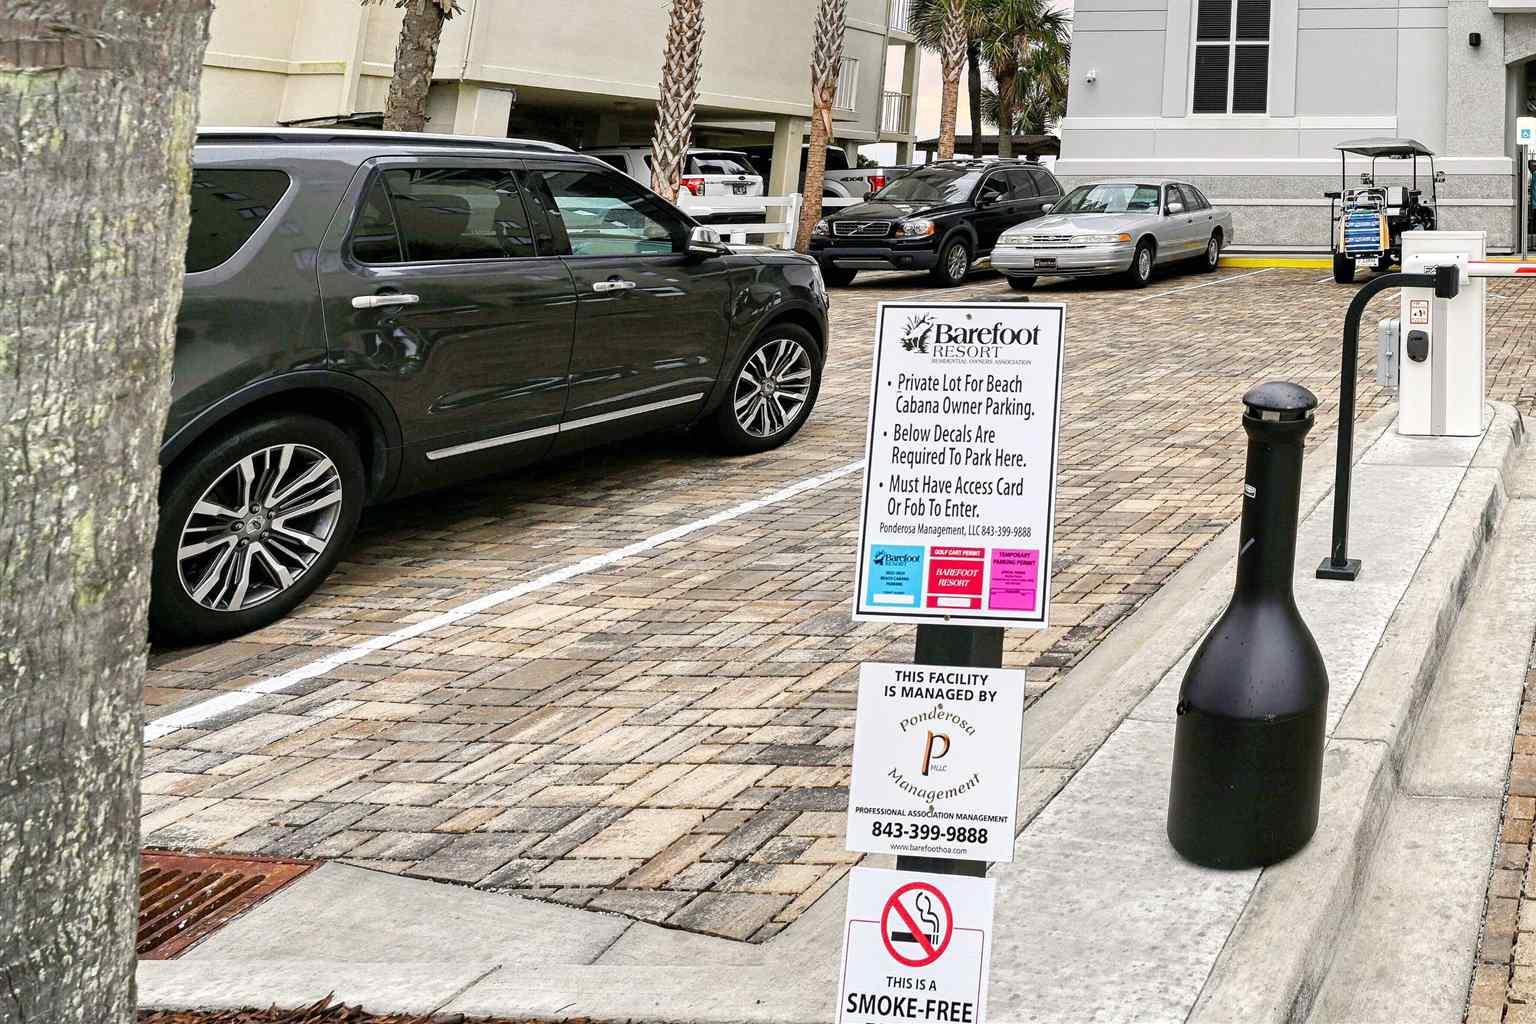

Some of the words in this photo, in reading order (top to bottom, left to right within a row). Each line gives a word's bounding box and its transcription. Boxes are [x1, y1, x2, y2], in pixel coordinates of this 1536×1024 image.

[935, 322, 1040, 346] Barefoot
[933, 345, 1001, 358] RESORT
[898, 373, 939, 392] Private
[942, 374, 961, 392] Lot
[964, 375, 983, 392] For
[986, 375, 1023, 393] Beach
[896, 395, 939, 414] Cabana
[942, 396, 982, 415] Owner
[986, 398, 1035, 420] Parking.
[893, 424, 930, 442] Below
[933, 424, 972, 443] Decals
[975, 426, 996, 444] Are
[891, 447, 945, 469] Required
[949, 448, 962, 465] To
[965, 448, 991, 467] Park
[995, 449, 1027, 468] Here.
[889, 475, 919, 494] Must
[922, 475, 951, 494] Have
[955, 477, 993, 496] Access
[996, 477, 1024, 496] Card
[887, 498, 902, 516] Or
[904, 498, 926, 516] Fob
[928, 499, 942, 517] To
[944, 499, 980, 518] Enter.
[880, 522, 916, 534] Ponderosa
[917, 523, 967, 537] Management,
[968, 525, 981, 536] LLC
[981, 526, 1032, 538] 843-399-9888
[885, 553, 921, 562] Barefoot
[936, 568, 980, 577] BAREFOOT
[938, 579, 970, 587] RESORT
[895, 670, 924, 683] THIS
[929, 672, 989, 686] FACILITY
[884, 685, 897, 697] IS
[900, 687, 974, 702] MANAGED
[978, 690, 998, 703] BY
[899, 706, 977, 736] Ponderosa
[887, 767, 981, 803] Management
[855, 806, 906, 817] PROFESSIONAL
[907, 810, 954, 820] ASSOCIATION
[955, 813, 1009, 824] MANAGEMENT
[871, 820, 989, 844] 843-399-9888
[886, 976, 913, 989] THIS
[916, 978, 926, 991] IS
[928, 979, 937, 991] A
[846, 992, 973, 1023] SMOKE-FREE
